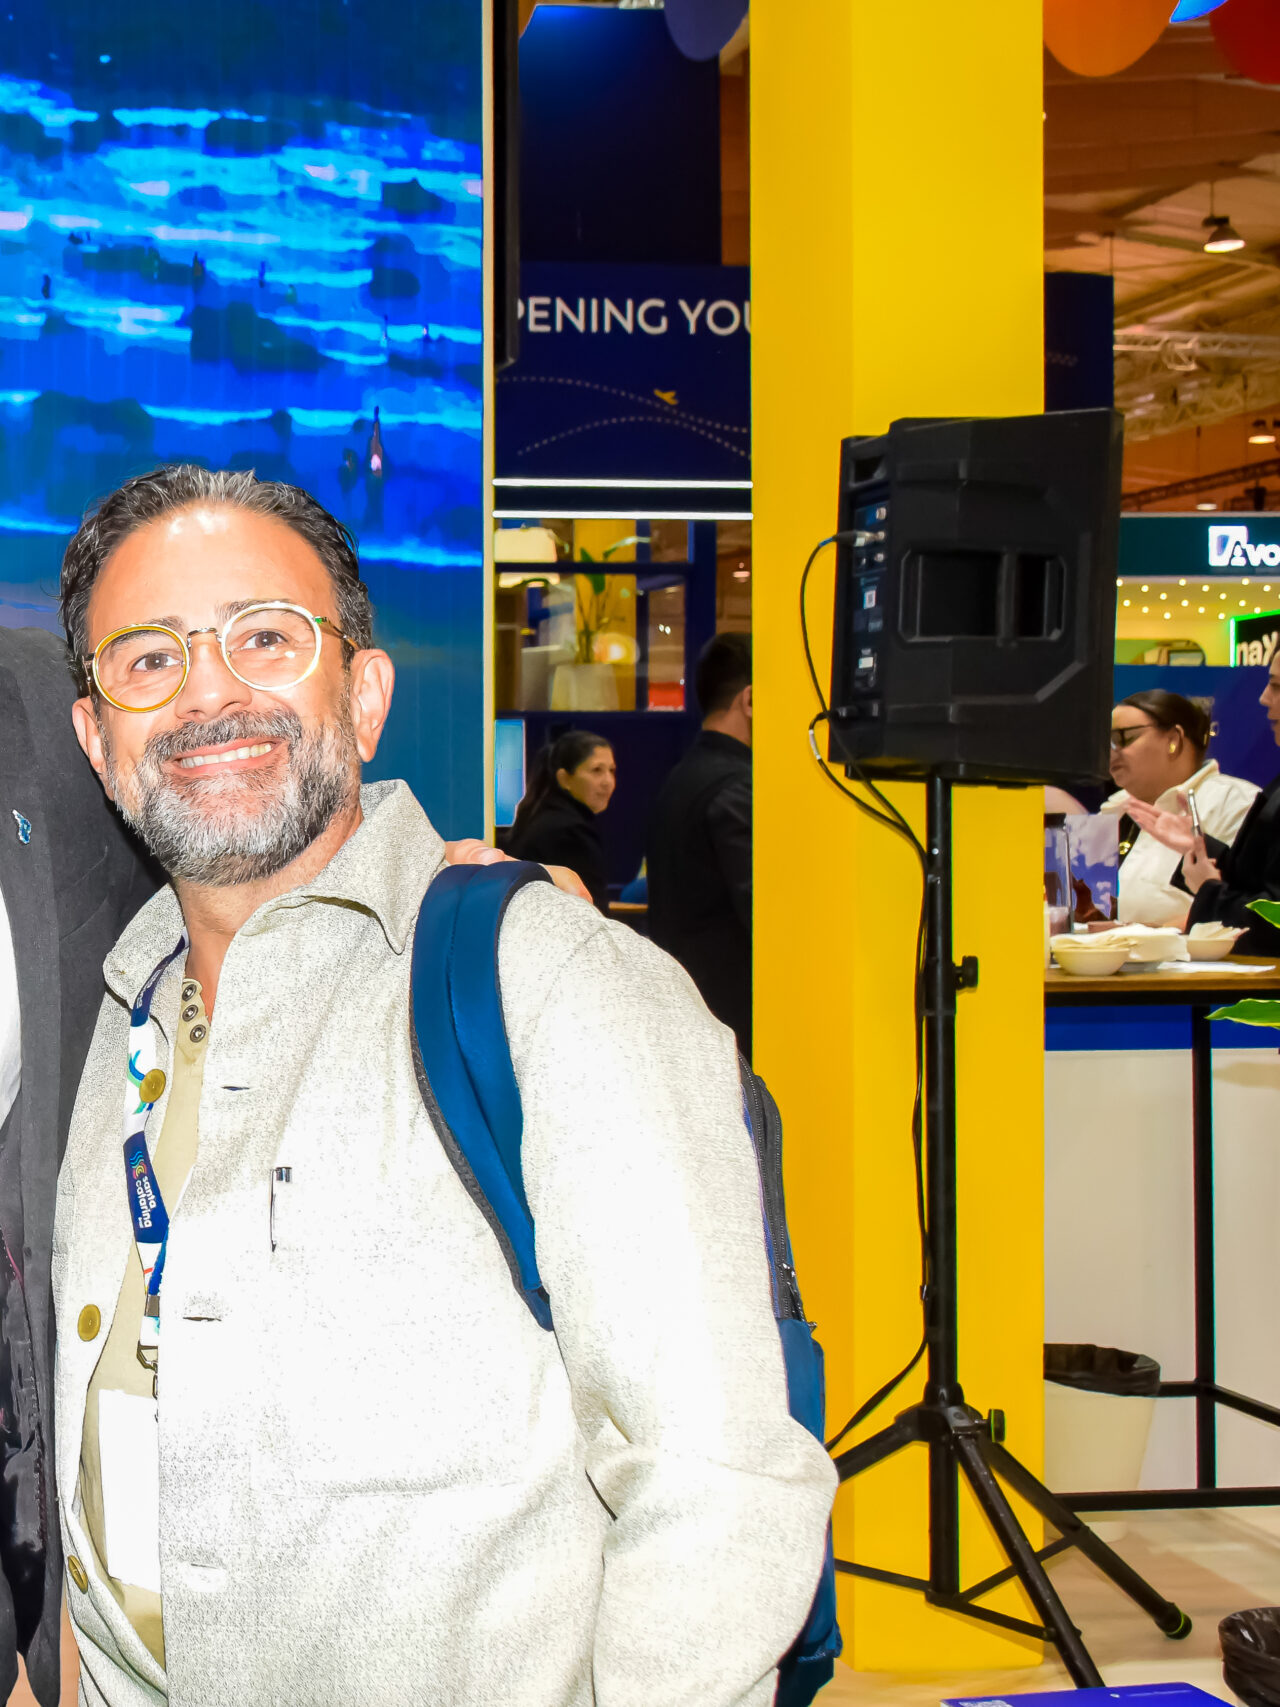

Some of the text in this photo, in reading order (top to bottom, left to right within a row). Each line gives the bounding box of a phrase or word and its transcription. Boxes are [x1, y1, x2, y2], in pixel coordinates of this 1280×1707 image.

[678, 299, 751, 336] YO
[136, 1180, 152, 1228] catarina
[142, 1175, 157, 1209] santa
